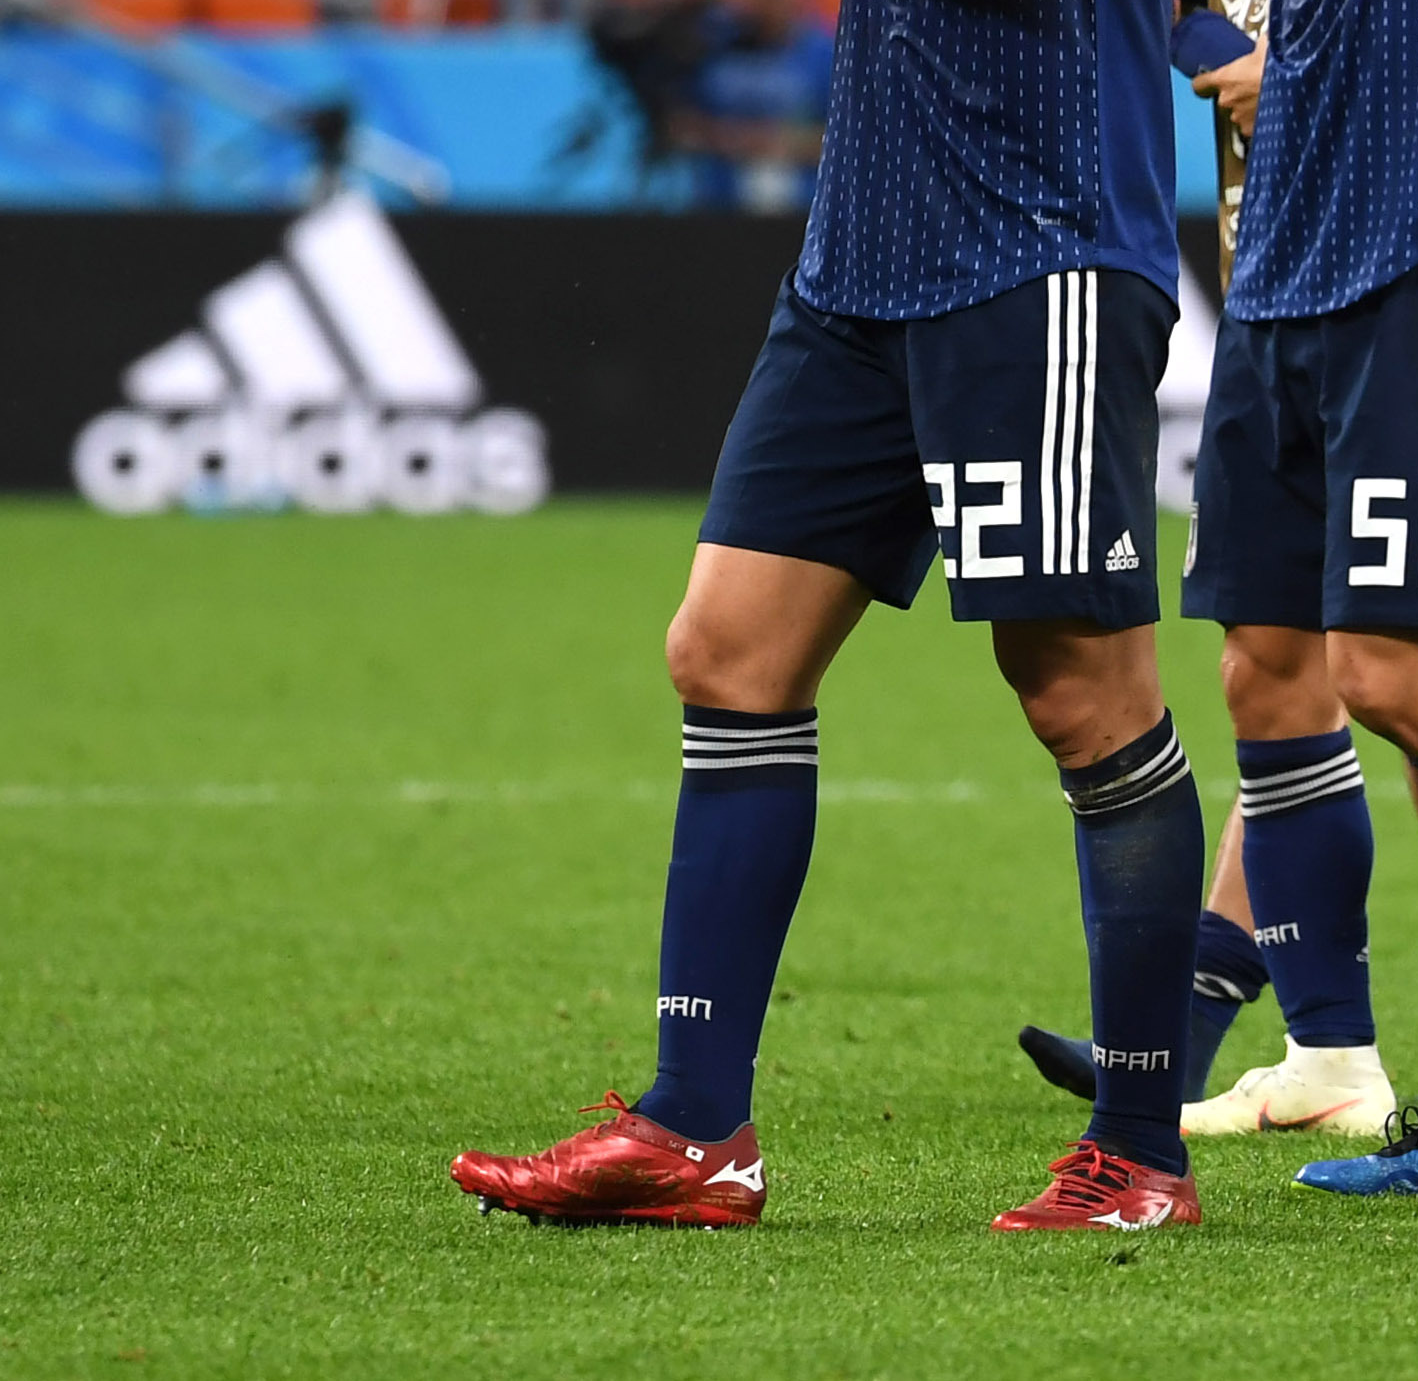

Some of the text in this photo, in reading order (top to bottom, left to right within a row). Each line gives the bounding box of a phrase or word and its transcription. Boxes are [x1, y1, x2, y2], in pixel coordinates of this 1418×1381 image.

[922, 461, 1024, 579] 22
[1347, 477, 1409, 587] 5
[1105, 554, 1140, 572] adidas
[1253, 922, 1300, 949] PAN
[656, 996, 713, 1021] PAN
